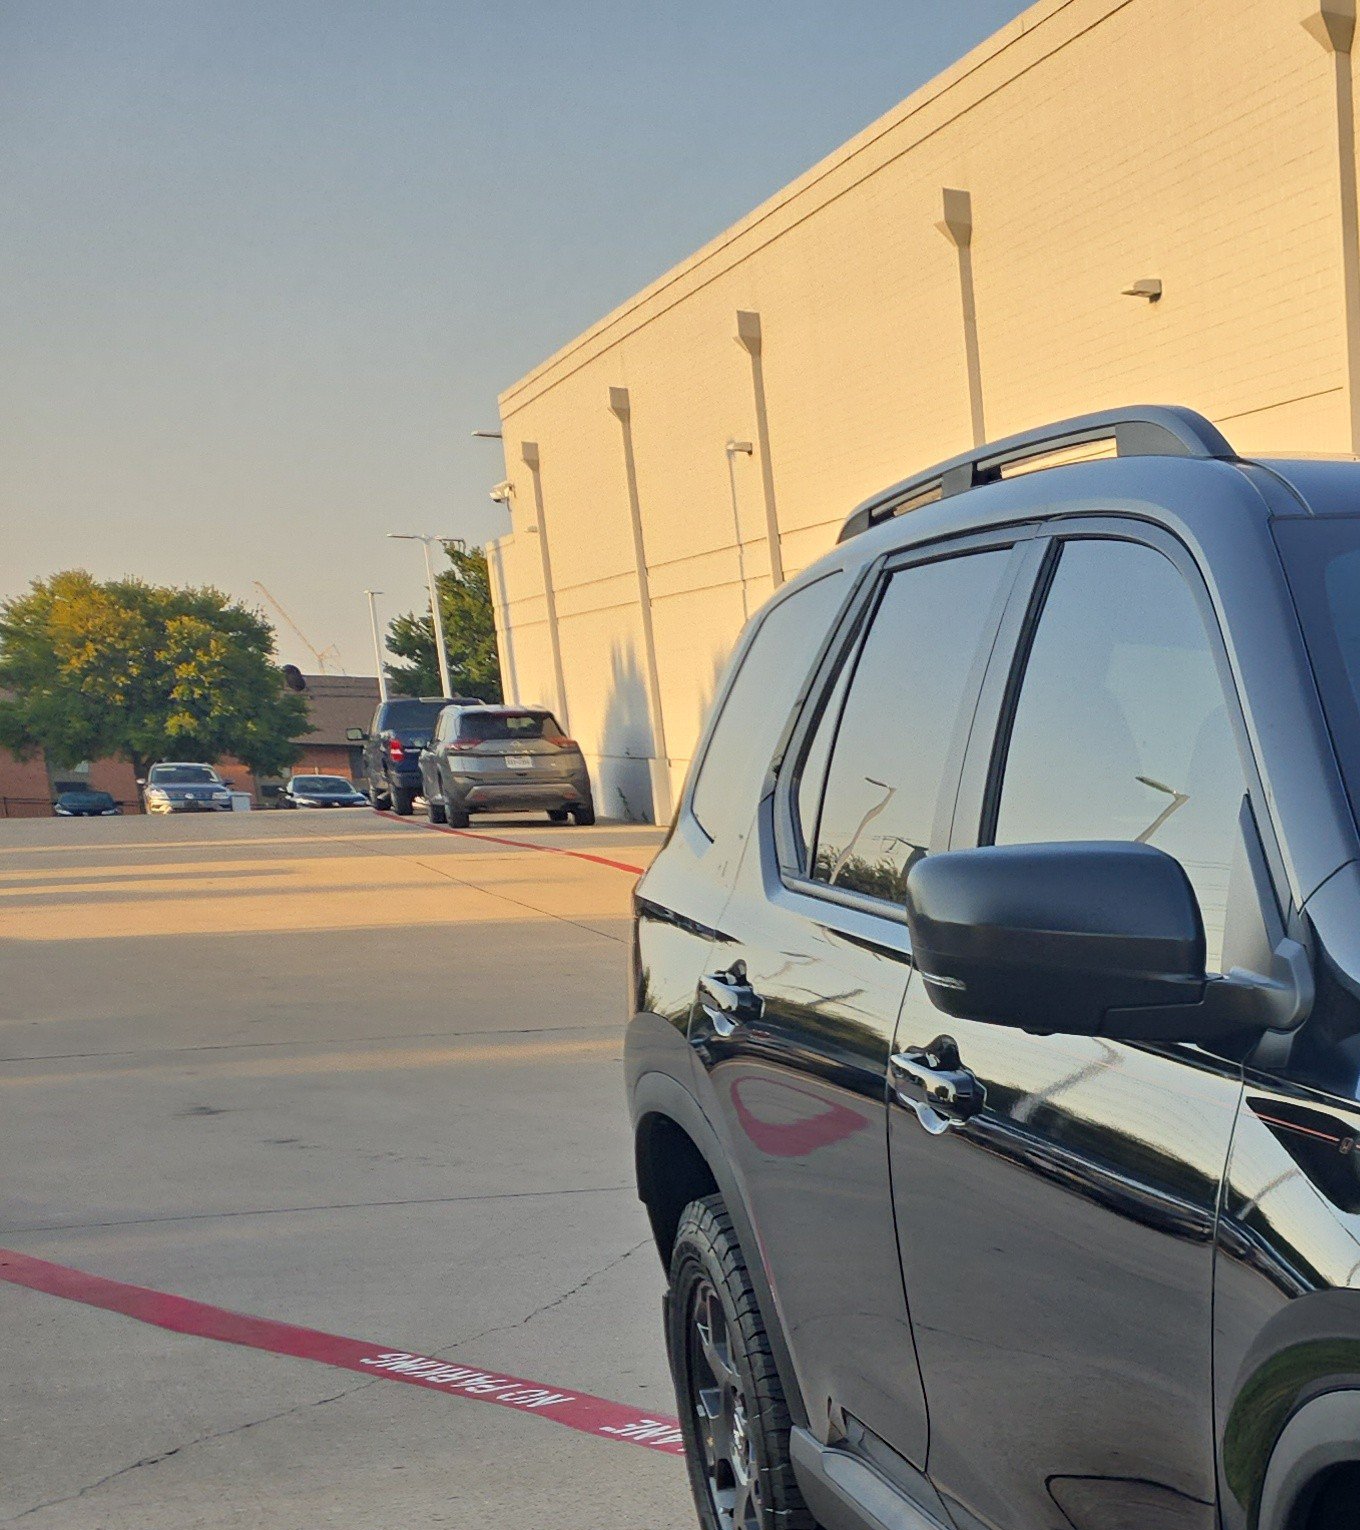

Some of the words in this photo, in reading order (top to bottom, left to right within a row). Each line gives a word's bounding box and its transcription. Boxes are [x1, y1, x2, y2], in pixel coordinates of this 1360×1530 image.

[360, 1353, 522, 1394] PARKING
[496, 1389, 576, 1407] NO
[600, 1419, 685, 1452] ANE
